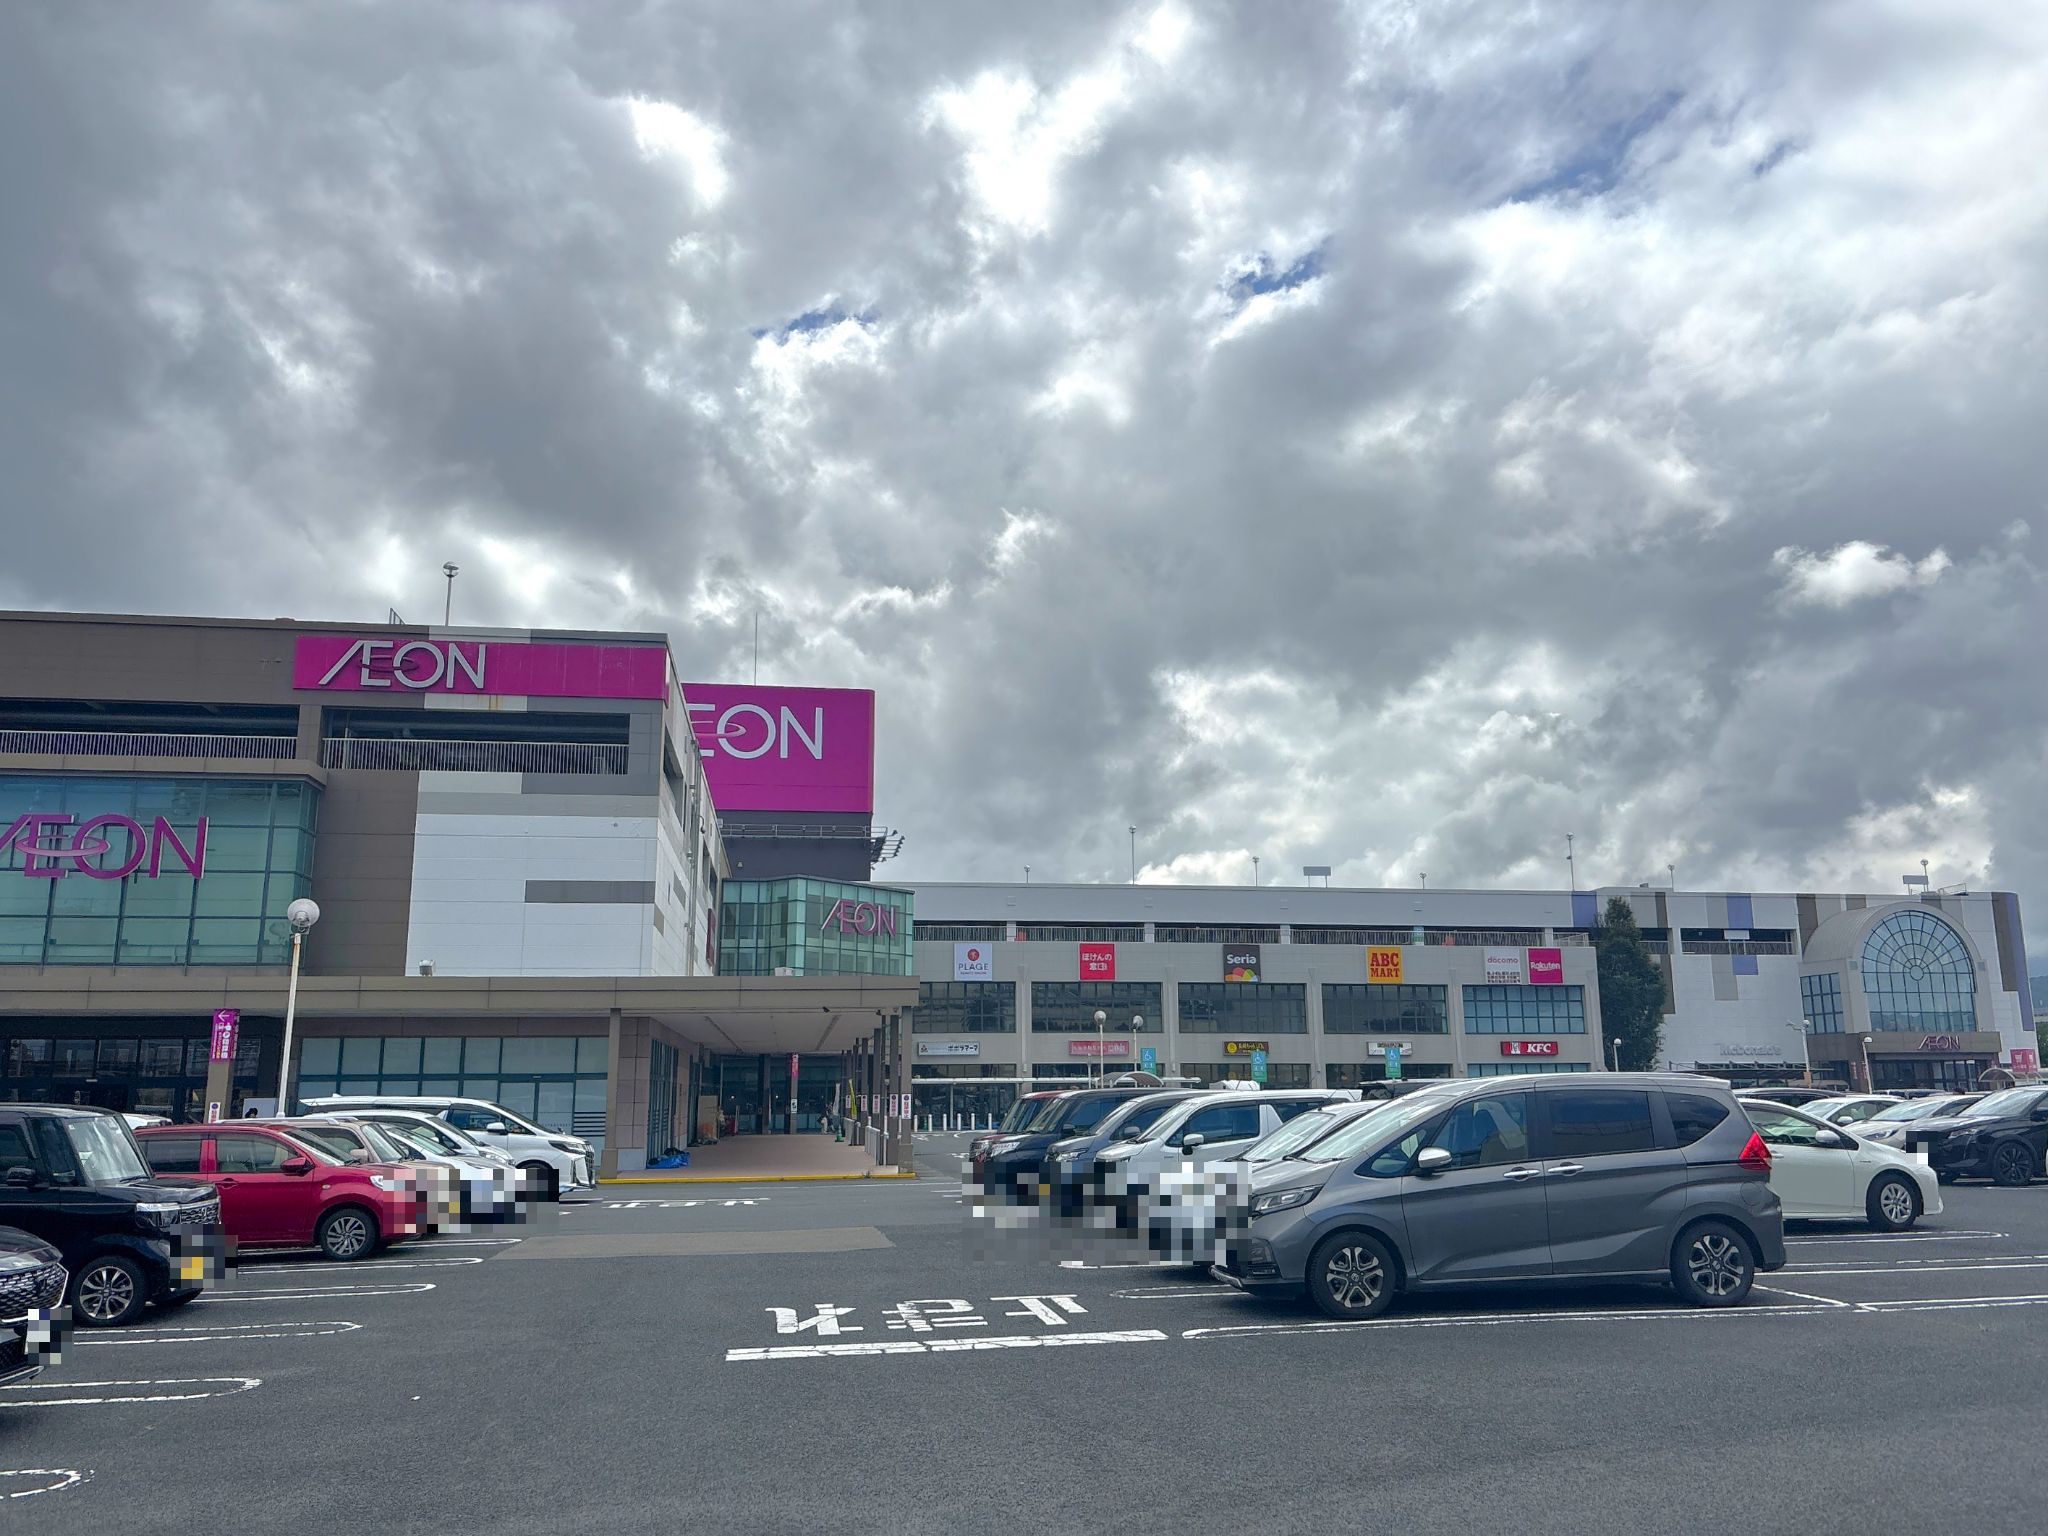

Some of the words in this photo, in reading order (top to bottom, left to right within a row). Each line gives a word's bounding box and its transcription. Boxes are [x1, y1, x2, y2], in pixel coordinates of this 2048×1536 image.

[1081, 952, 1113, 962] ほけんの
[1226, 953, 1257, 966] Seria
[1370, 952, 1399, 967] ABC
[1487, 956, 1519, 964] docomo
[958, 962, 989, 971] PLAGE
[1530, 961, 1561, 971] Rakuten
[1370, 967, 1400, 978] MART
[1526, 1043, 1552, 1053] KFC
[765, 1294, 1089, 1336] 止まれ
